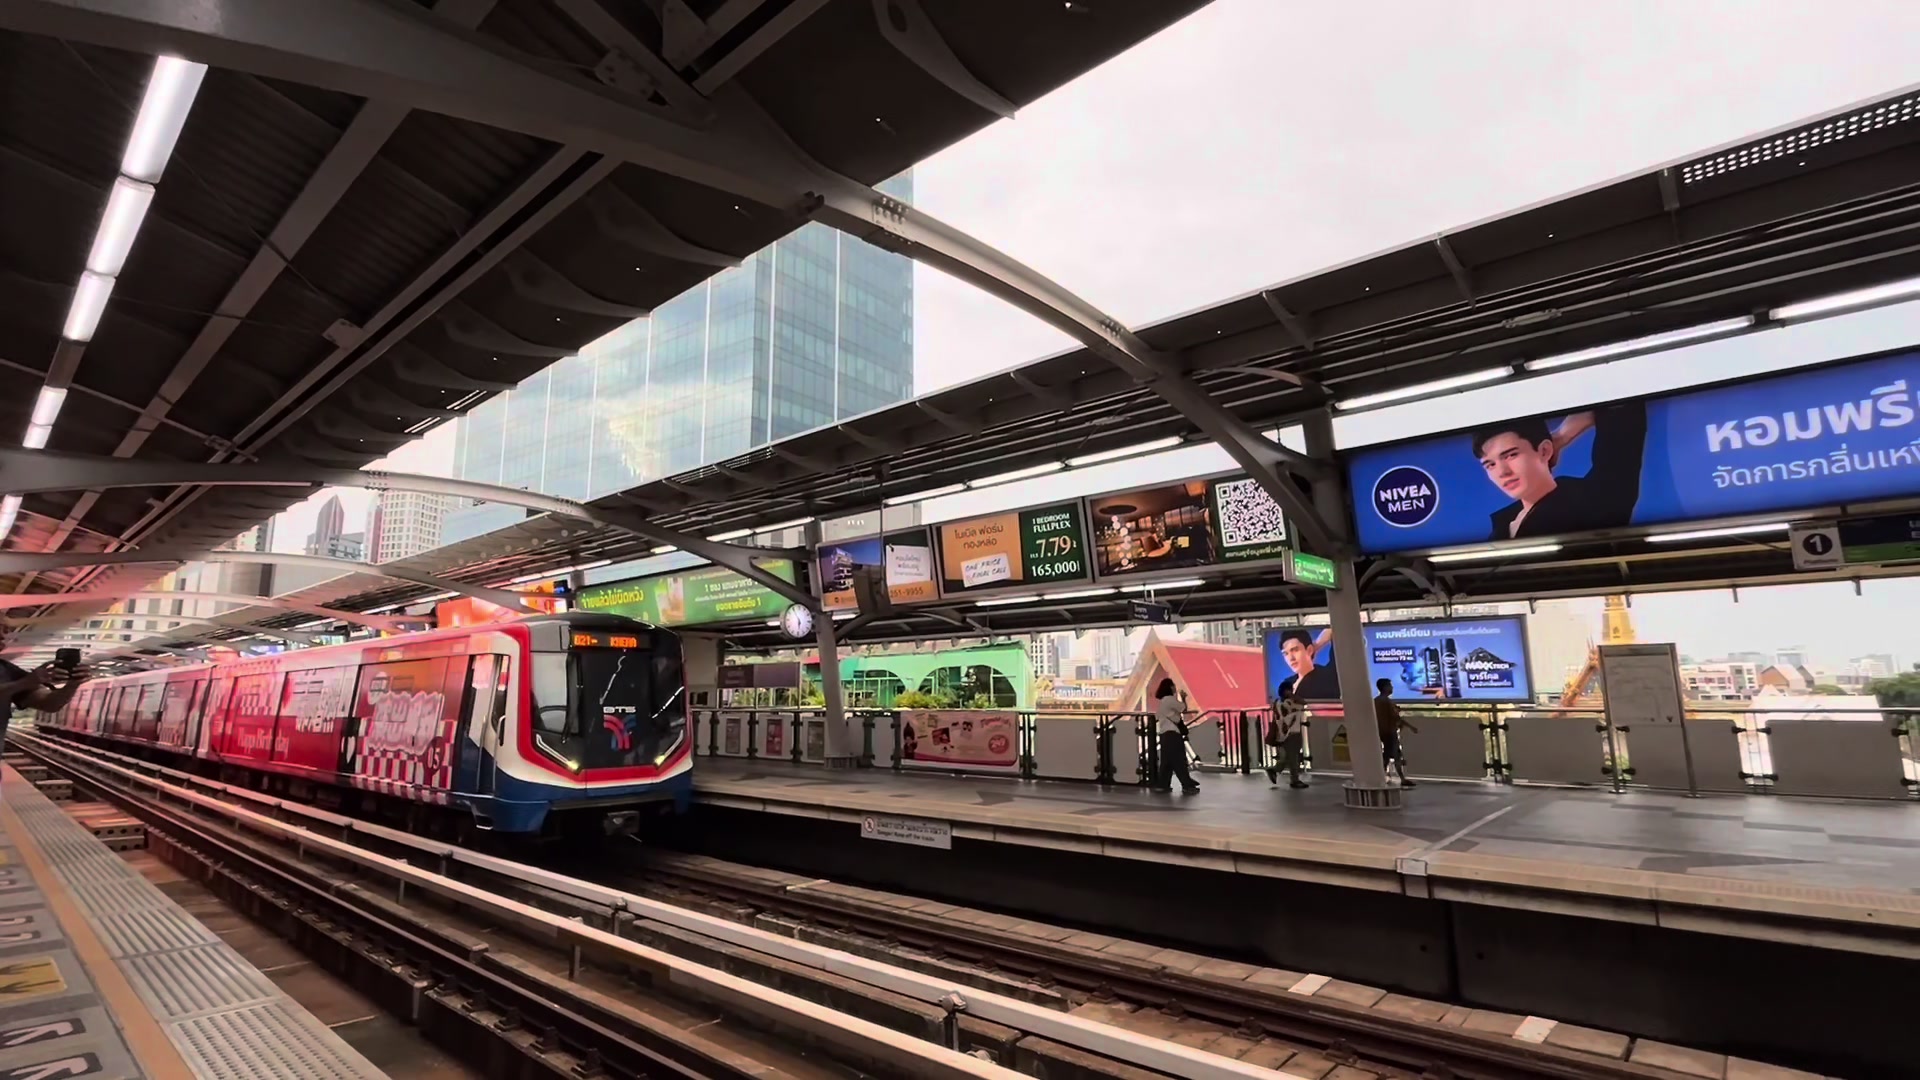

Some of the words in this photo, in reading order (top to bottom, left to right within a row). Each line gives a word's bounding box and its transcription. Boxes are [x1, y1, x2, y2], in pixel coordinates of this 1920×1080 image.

[1705, 379, 1920, 453] หอมพรี
[1379, 483, 1431, 502] NIVEA
[1388, 498, 1425, 513] MEN
[1033, 520, 1071, 533] FULLPLEX
[1036, 513, 1070, 524] BEDROOM
[1036, 535, 1072, 558] 7.79
[1810, 535, 1823, 552] 1
[1032, 560, 1077, 577] 165,000
